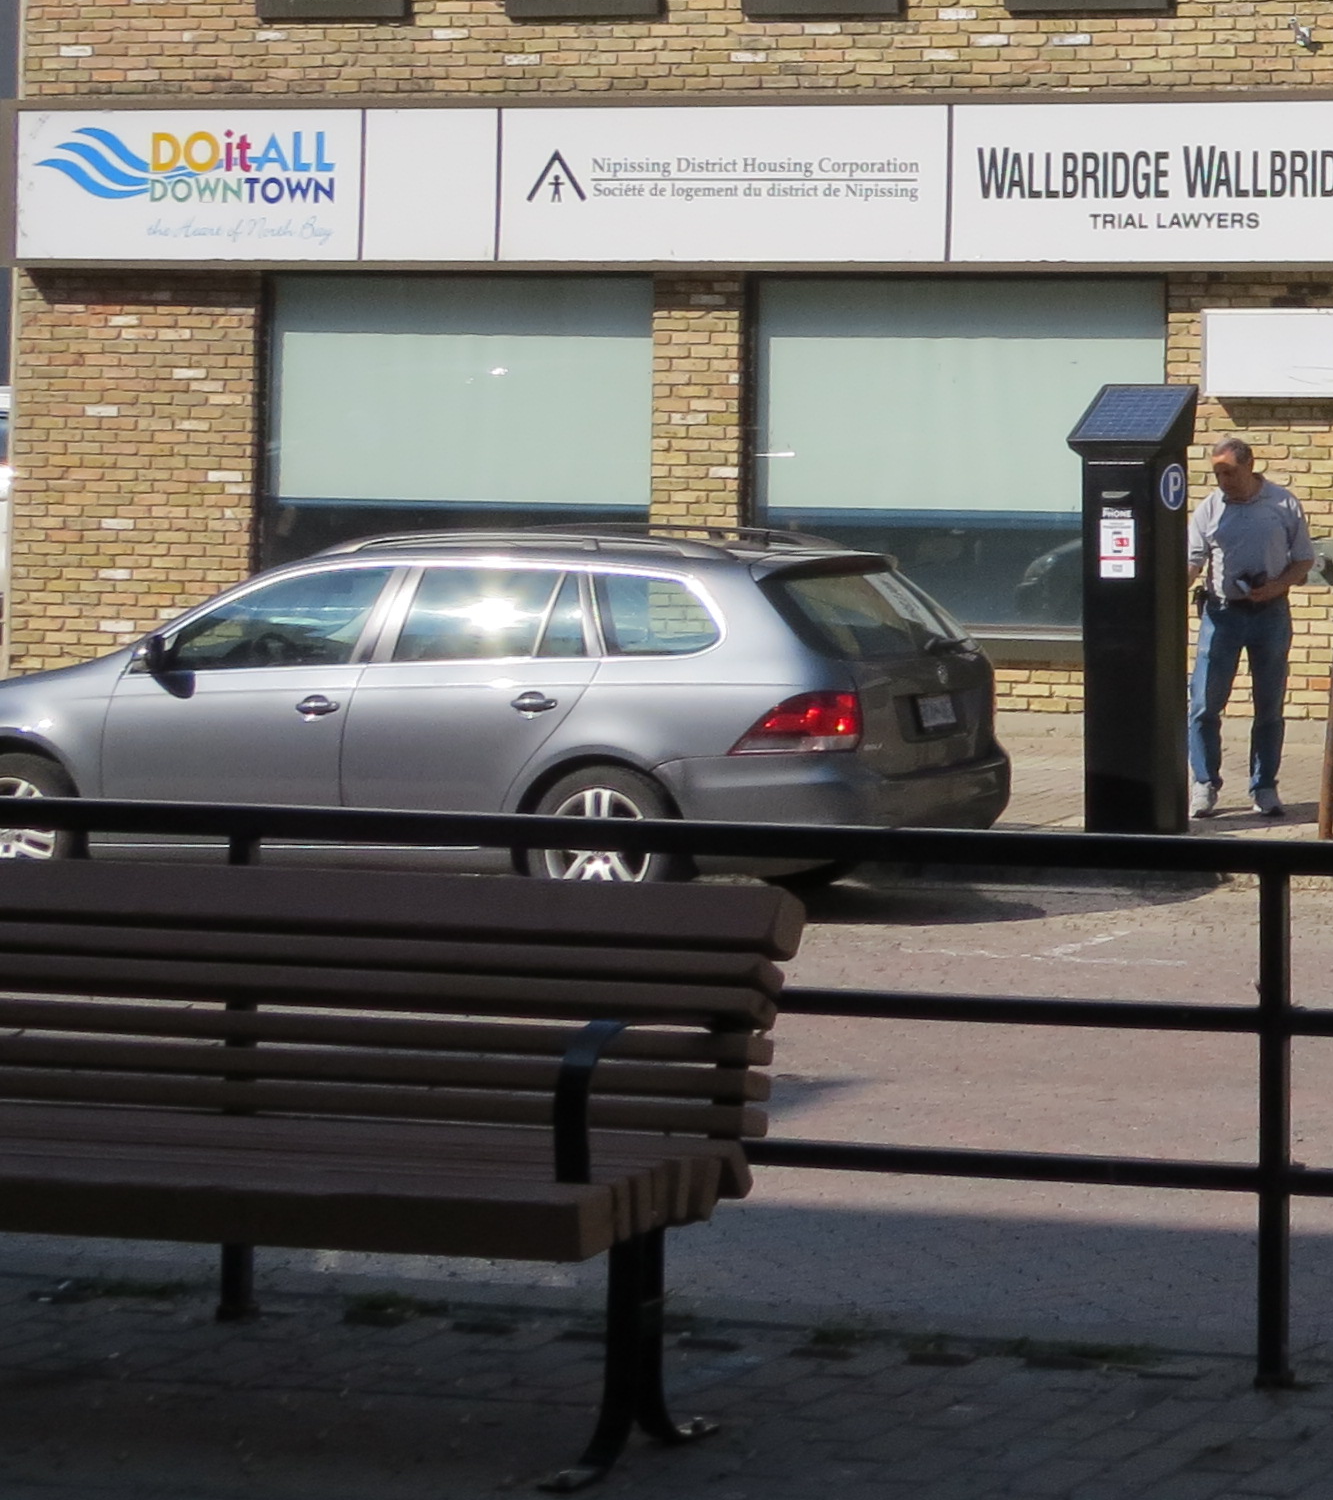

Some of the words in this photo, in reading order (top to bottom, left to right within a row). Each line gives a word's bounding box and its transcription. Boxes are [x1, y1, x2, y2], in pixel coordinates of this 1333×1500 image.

[591, 157, 672, 177] Nipissing
[676, 157, 738, 173] District
[743, 157, 813, 178] Housing
[818, 157, 920, 178] Corporation
[977, 146, 1170, 199] WALLBRIDGE
[149, 177, 335, 204] DOWNTOWN
[592, 183, 645, 197] Société
[649, 183, 667, 197] de
[671, 183, 739, 201] logement
[743, 183, 762, 197] du
[766, 183, 819, 197] district
[822, 183, 841, 198] de
[845, 183, 919, 202] Nipissing
[147, 218, 169, 238] the
[225, 218, 245, 243] of
[247, 214, 294, 239] North
[299, 215, 335, 246] Bay
[1089, 212, 1149, 230] TRIAL
[1156, 212, 1260, 230] LAWYERS
[1168, 472, 1182, 502] P
